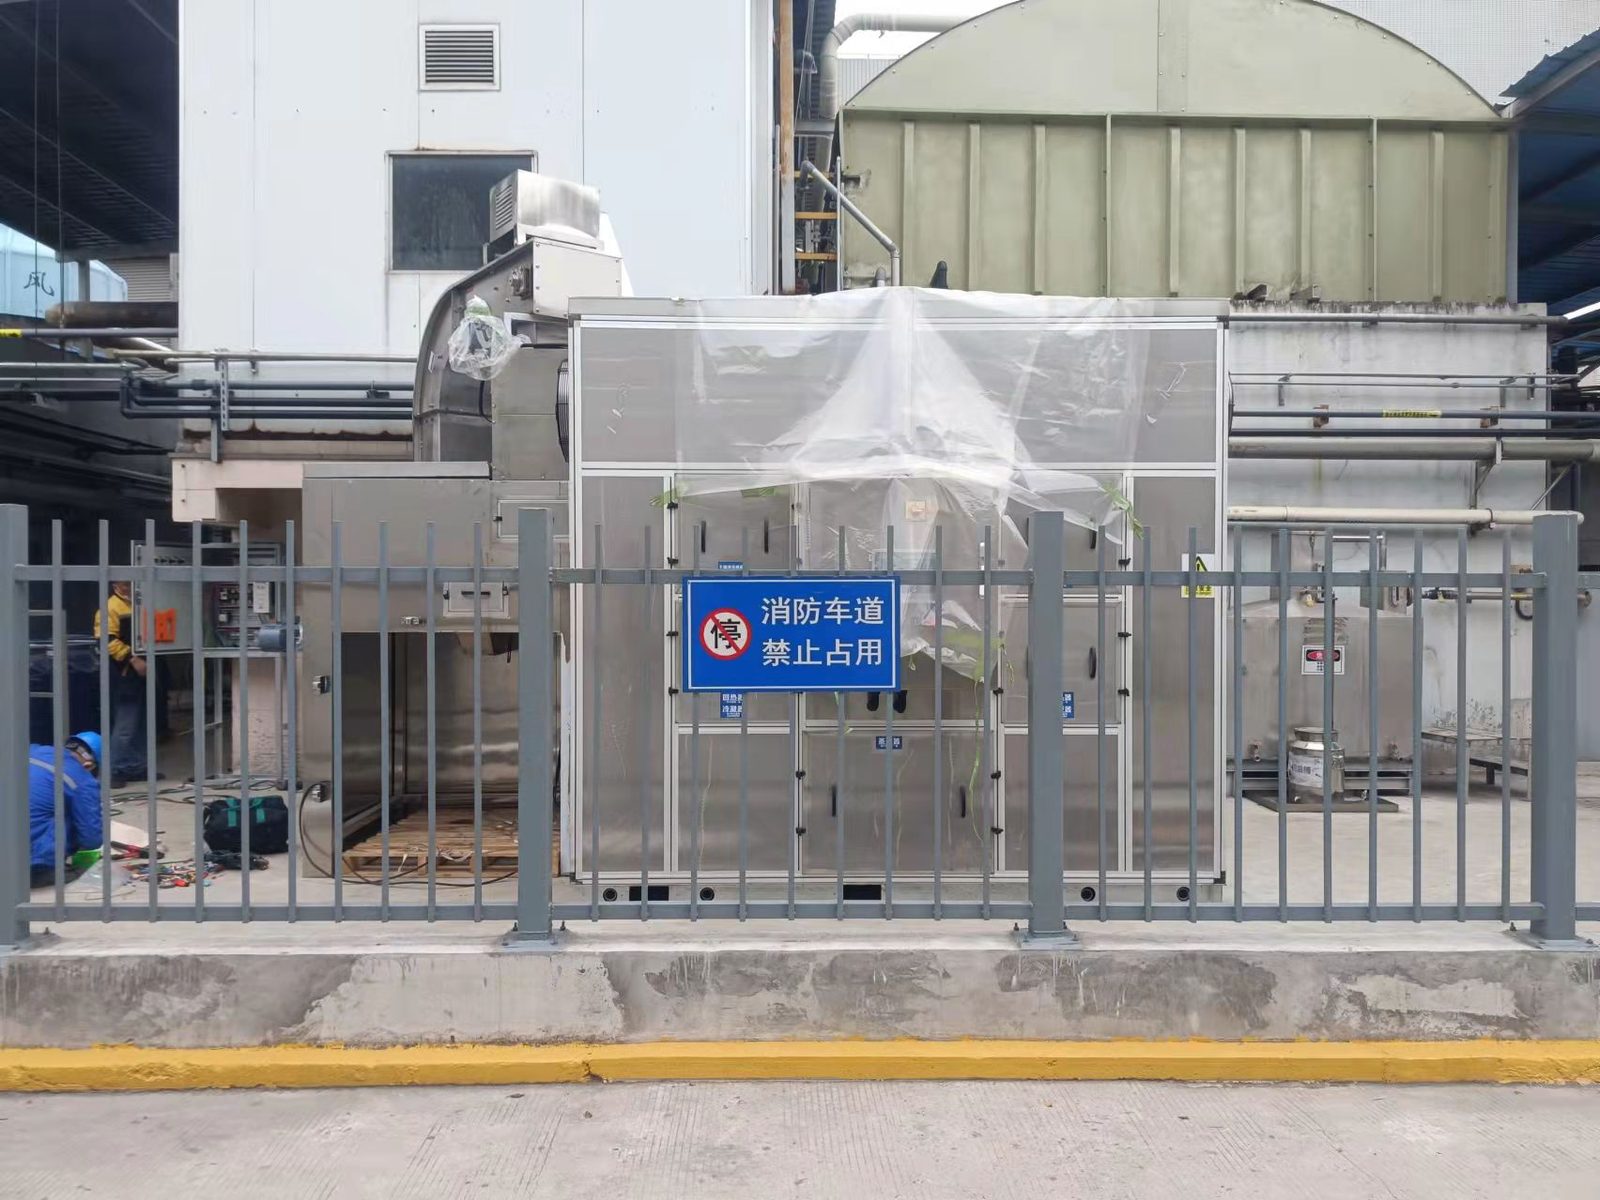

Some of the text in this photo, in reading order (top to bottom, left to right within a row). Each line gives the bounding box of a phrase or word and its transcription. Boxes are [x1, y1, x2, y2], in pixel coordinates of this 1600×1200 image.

[761, 597, 884, 625] 消防车道
[710, 618, 741, 649] 停
[761, 639, 882, 667] 禁止占用
